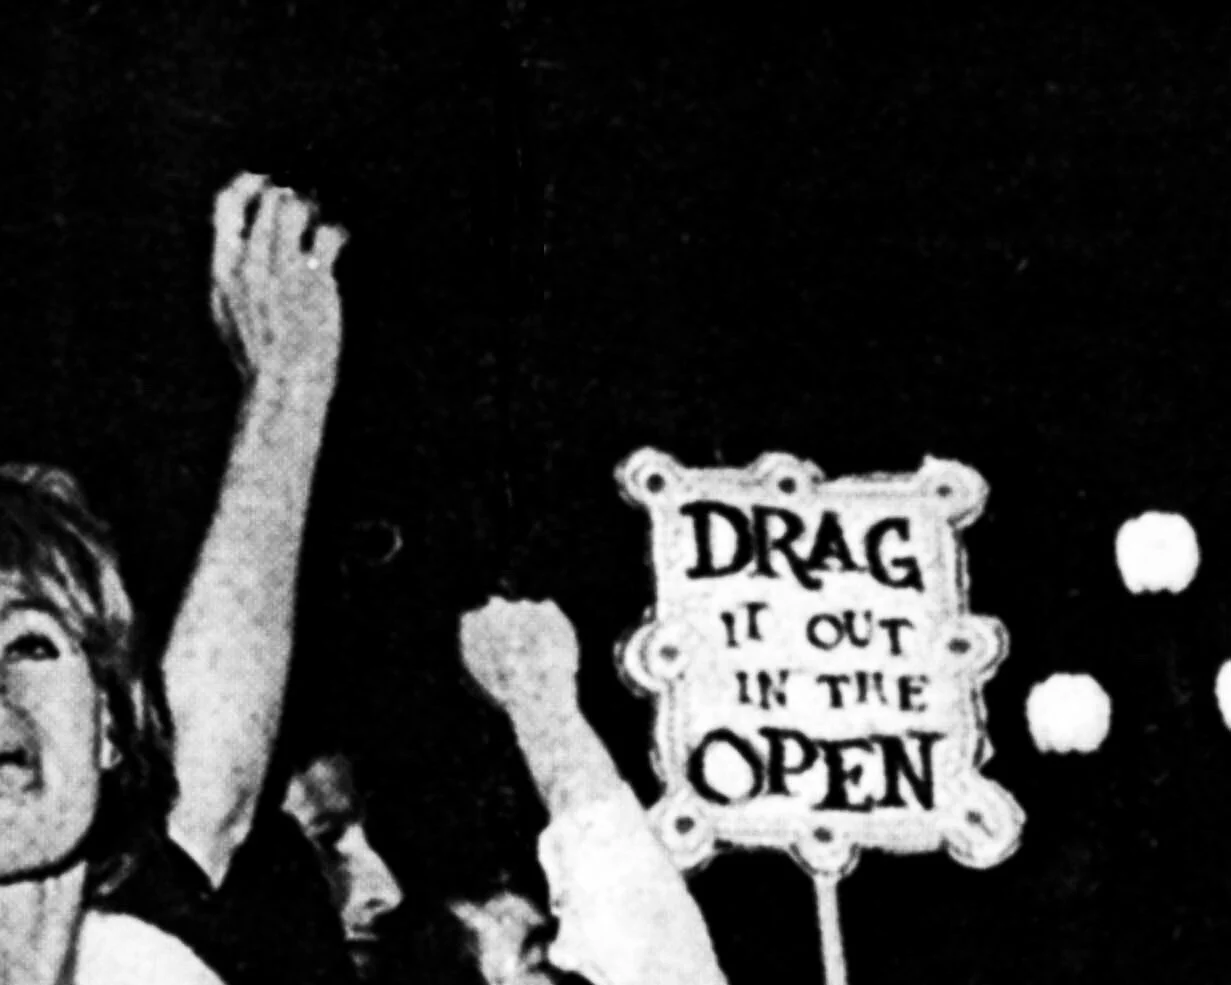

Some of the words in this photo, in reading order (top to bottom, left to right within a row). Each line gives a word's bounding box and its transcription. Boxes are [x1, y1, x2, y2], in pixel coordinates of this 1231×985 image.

[679, 499, 925, 592] DRAG
[720, 601, 769, 648] IT
[806, 609, 914, 656] OUT
[735, 669, 790, 710] IN
[816, 670, 929, 711] THE
[685, 726, 945, 812] OPEN
